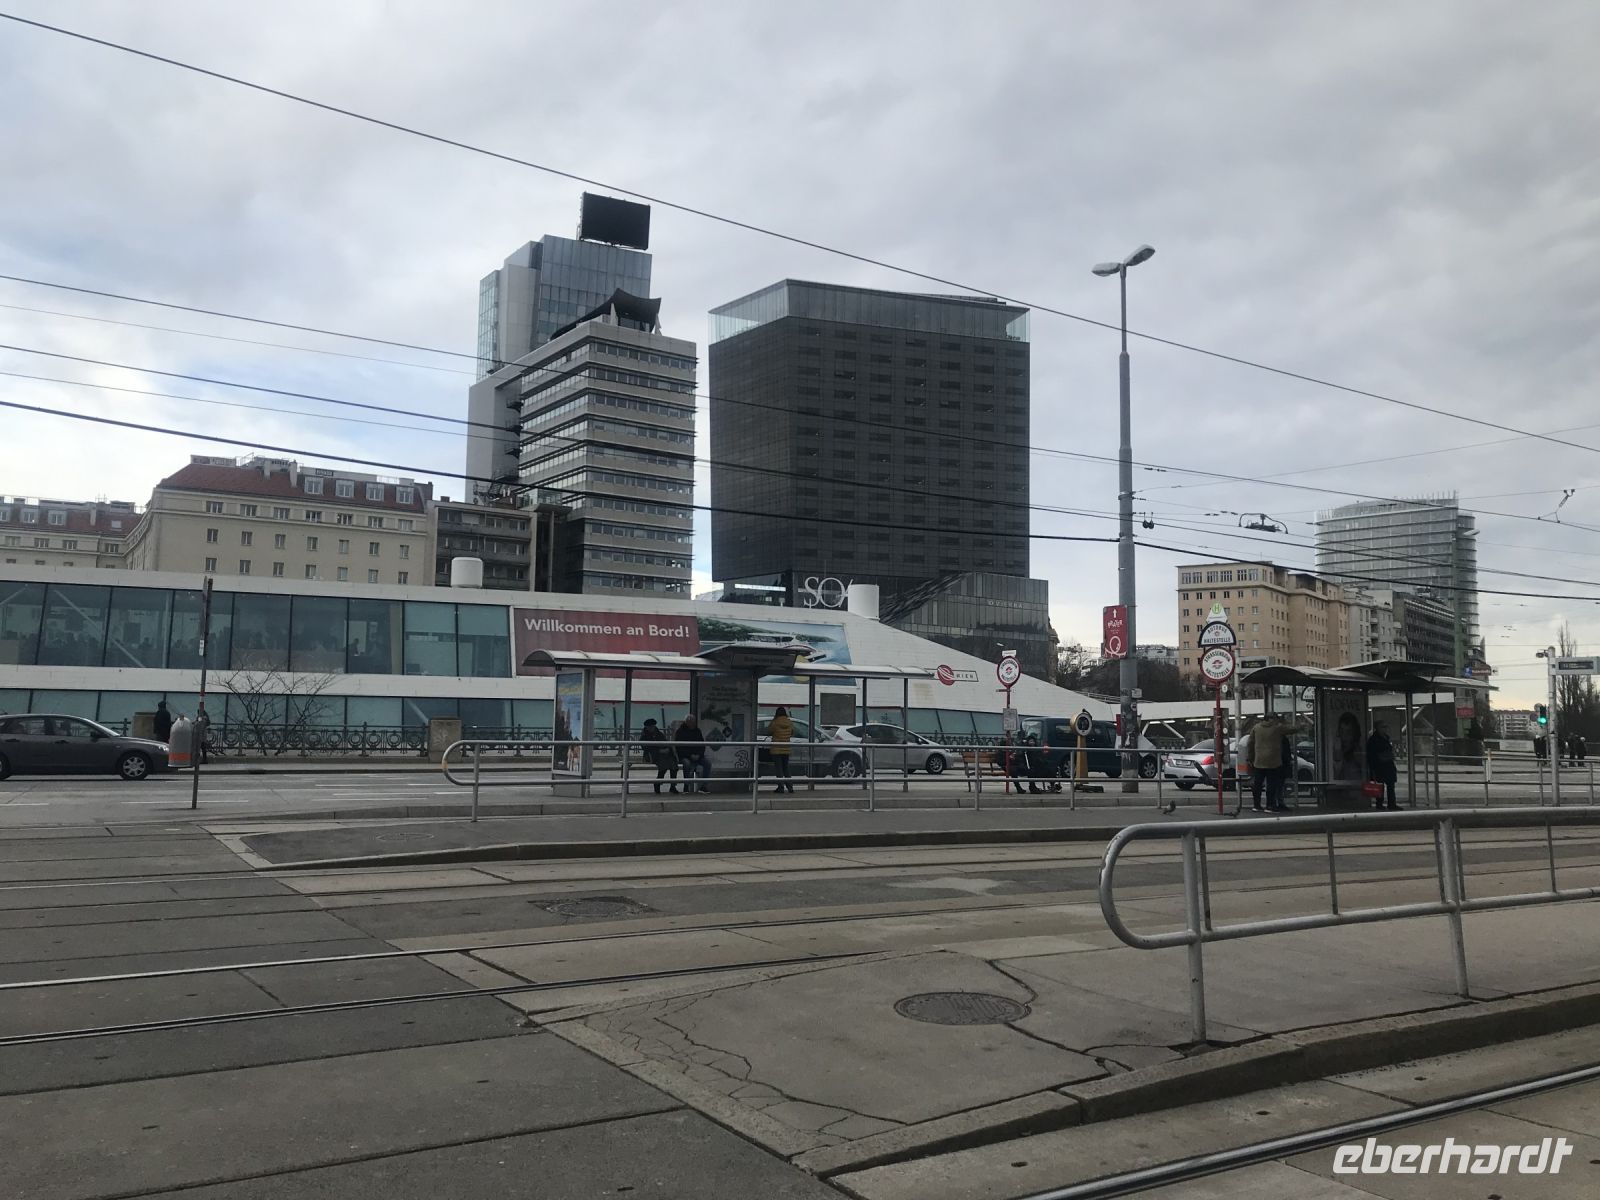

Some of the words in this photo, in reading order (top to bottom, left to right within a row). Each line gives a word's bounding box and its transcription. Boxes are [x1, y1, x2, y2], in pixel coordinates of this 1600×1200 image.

[524, 618, 621, 635] Willkommen
[626, 626, 644, 636] an
[648, 624, 689, 637] Bord!
